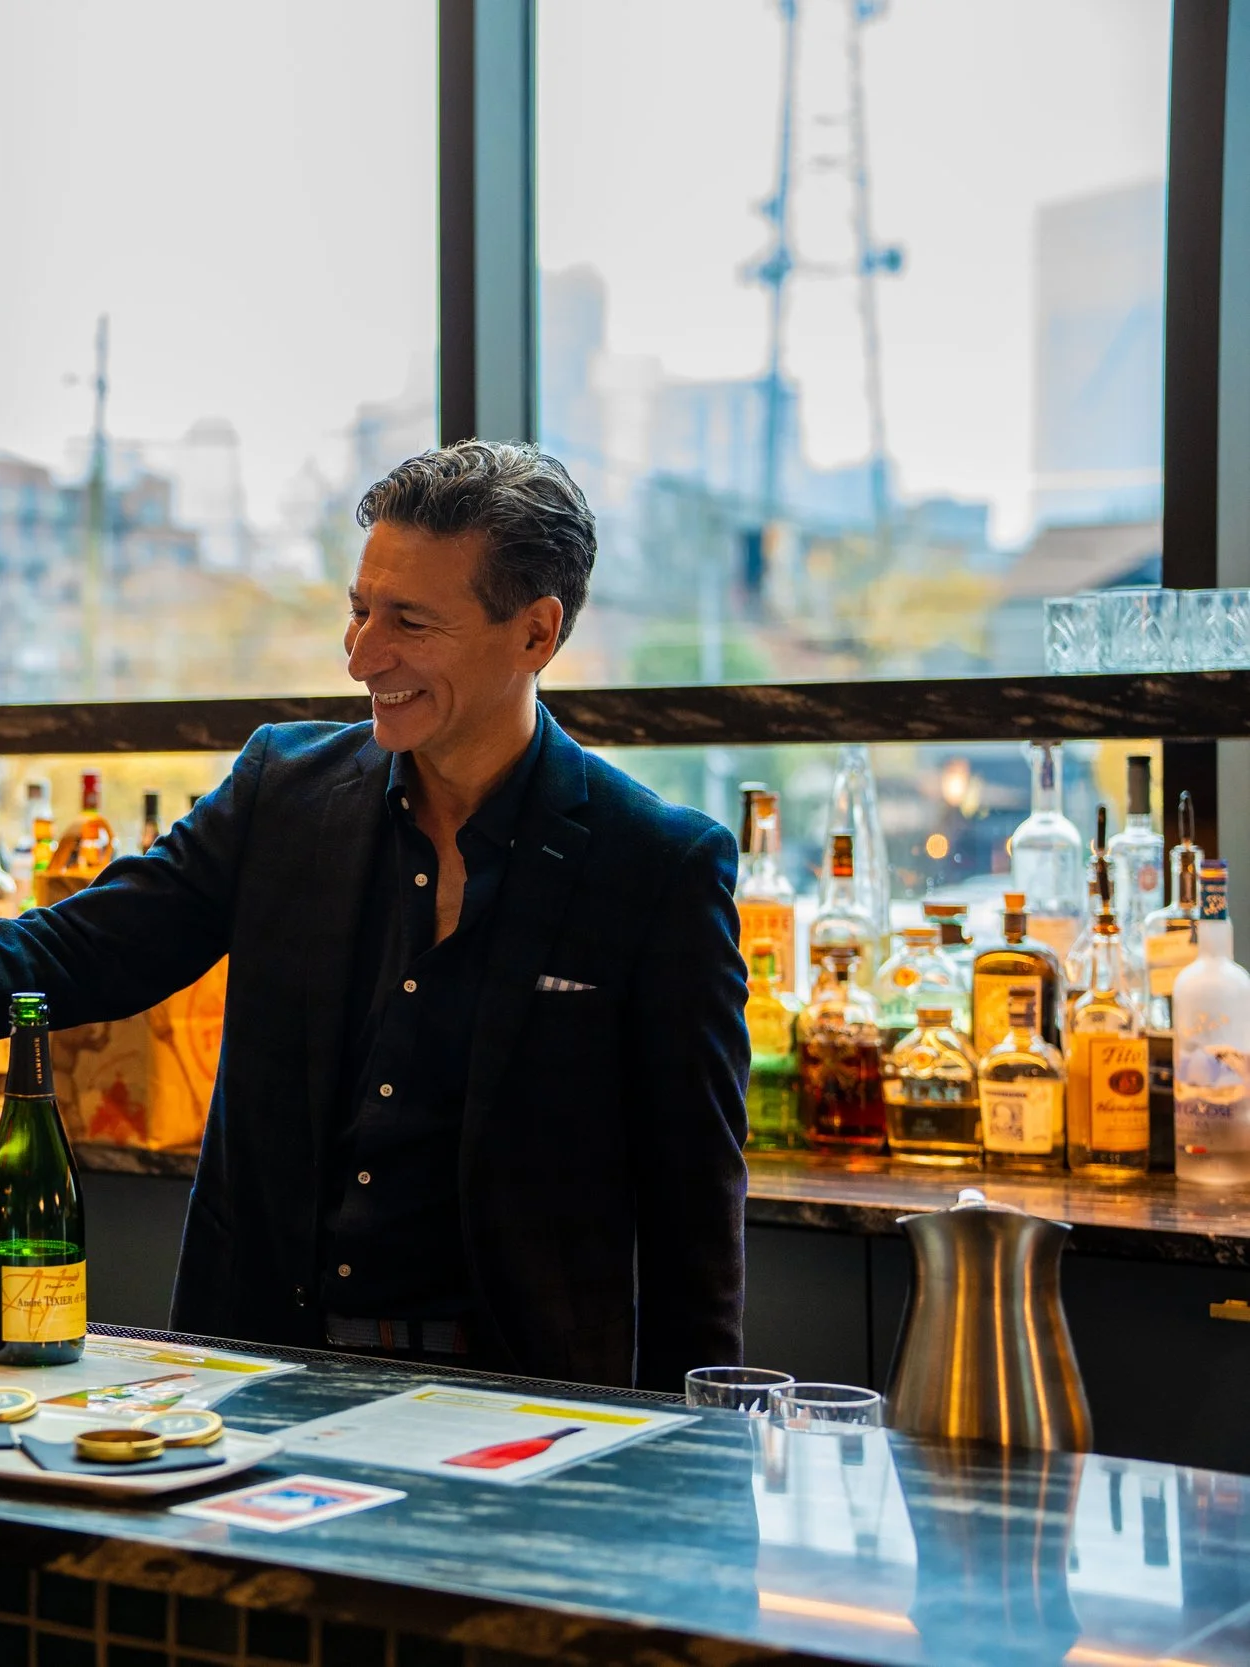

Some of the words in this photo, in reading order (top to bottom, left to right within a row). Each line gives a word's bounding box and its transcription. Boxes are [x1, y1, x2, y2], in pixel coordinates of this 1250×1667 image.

[34, 1037, 42, 1084] CHAMPAGNE
[18, 1298, 42, 1307] André
[44, 1295, 73, 1306] TIXIER
